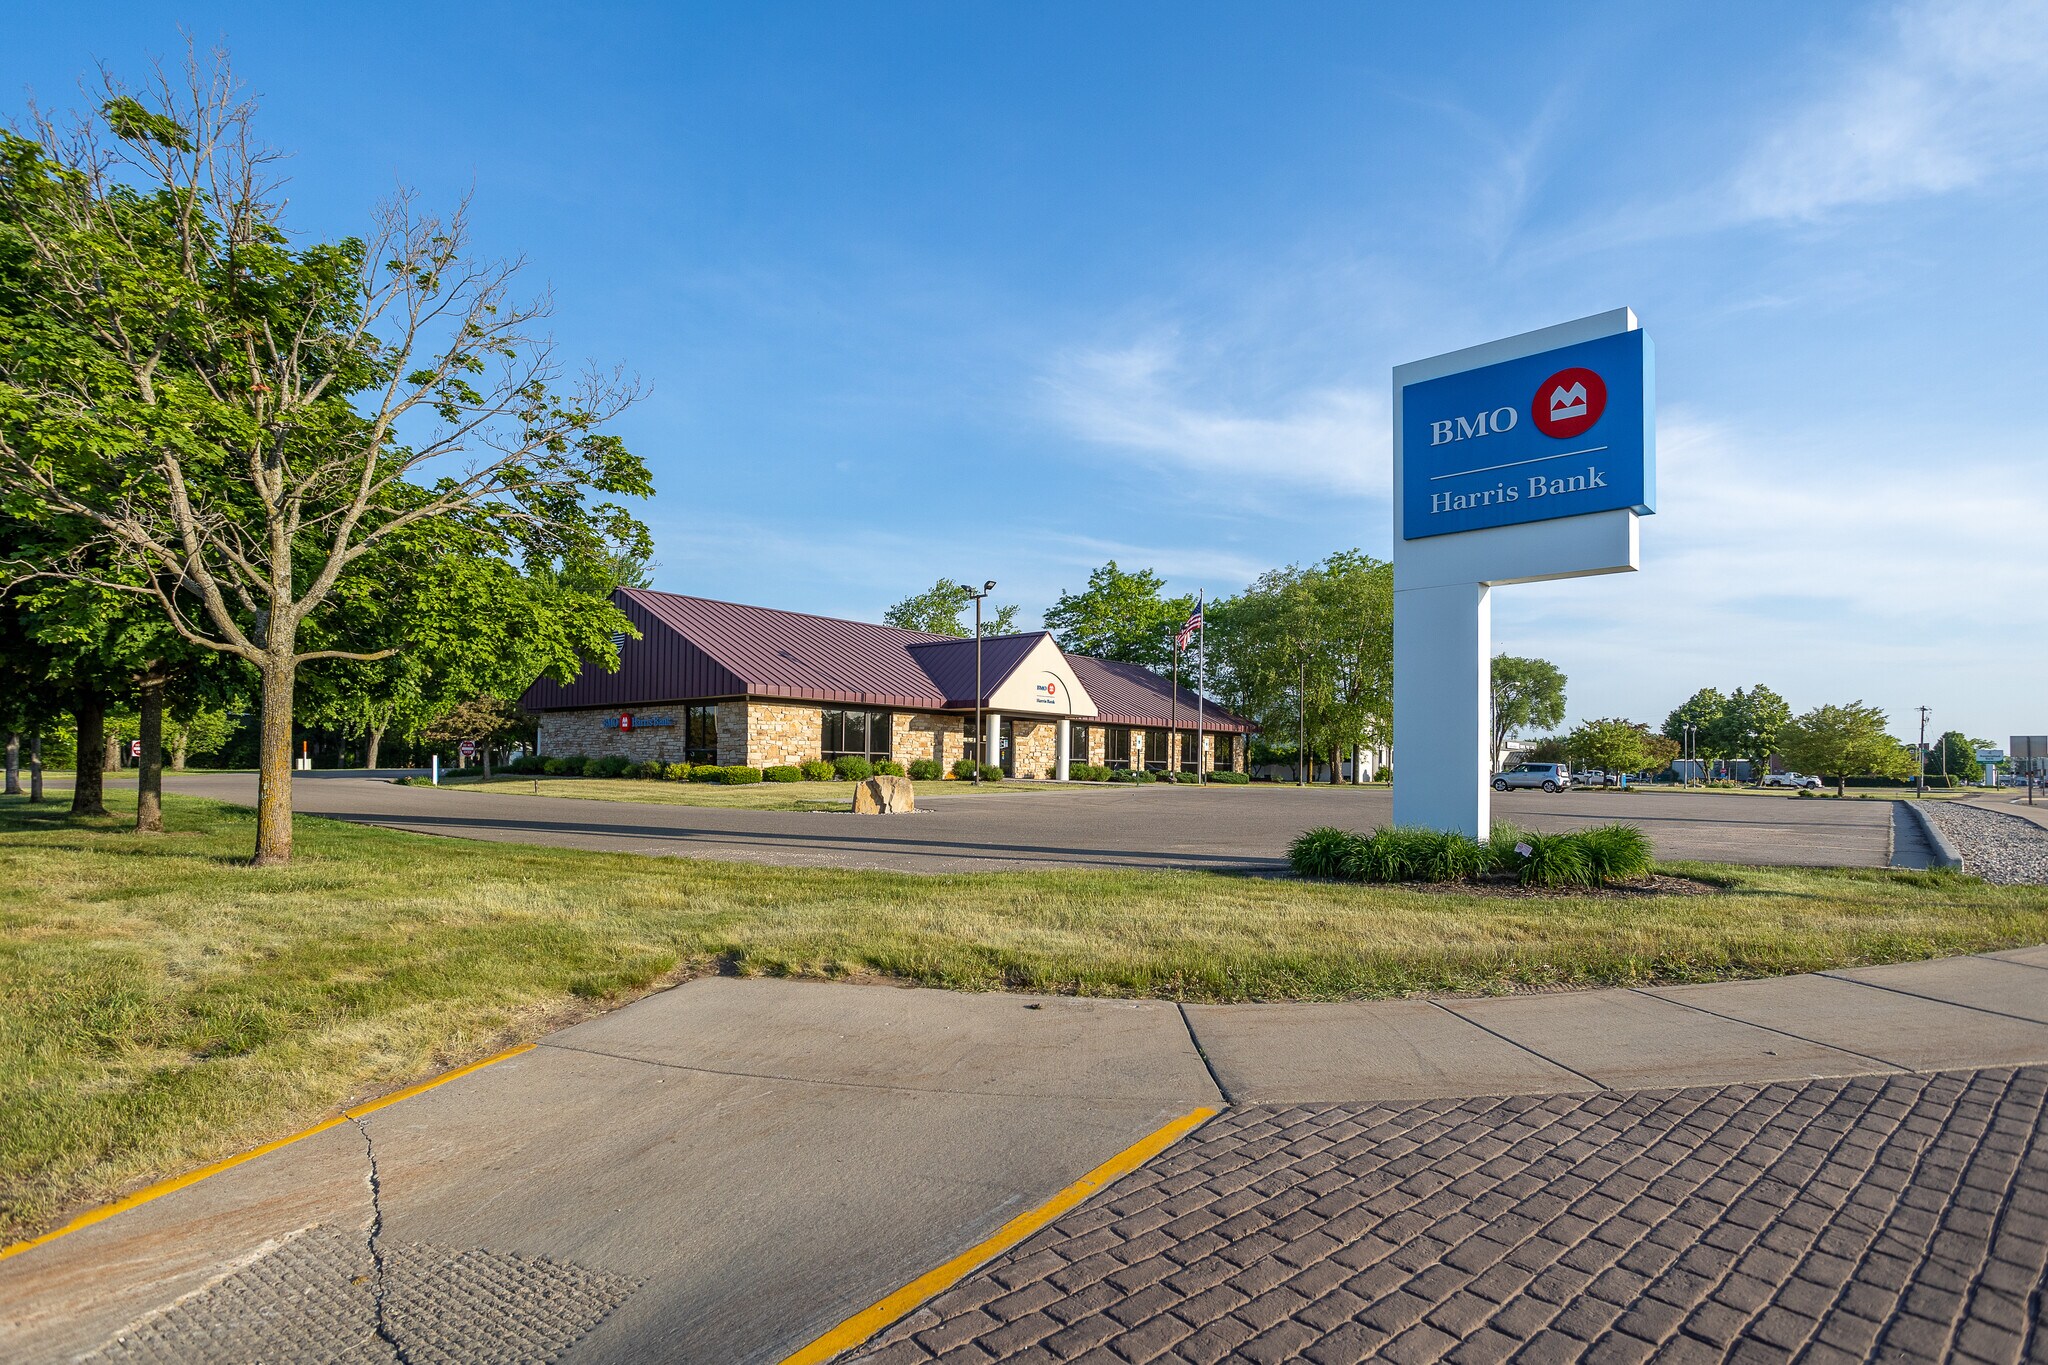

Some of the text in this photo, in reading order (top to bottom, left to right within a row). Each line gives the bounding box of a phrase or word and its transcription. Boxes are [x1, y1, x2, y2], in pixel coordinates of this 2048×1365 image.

[1430, 406, 1518, 446] BMO
[1430, 466, 1608, 514] Harris Bank
